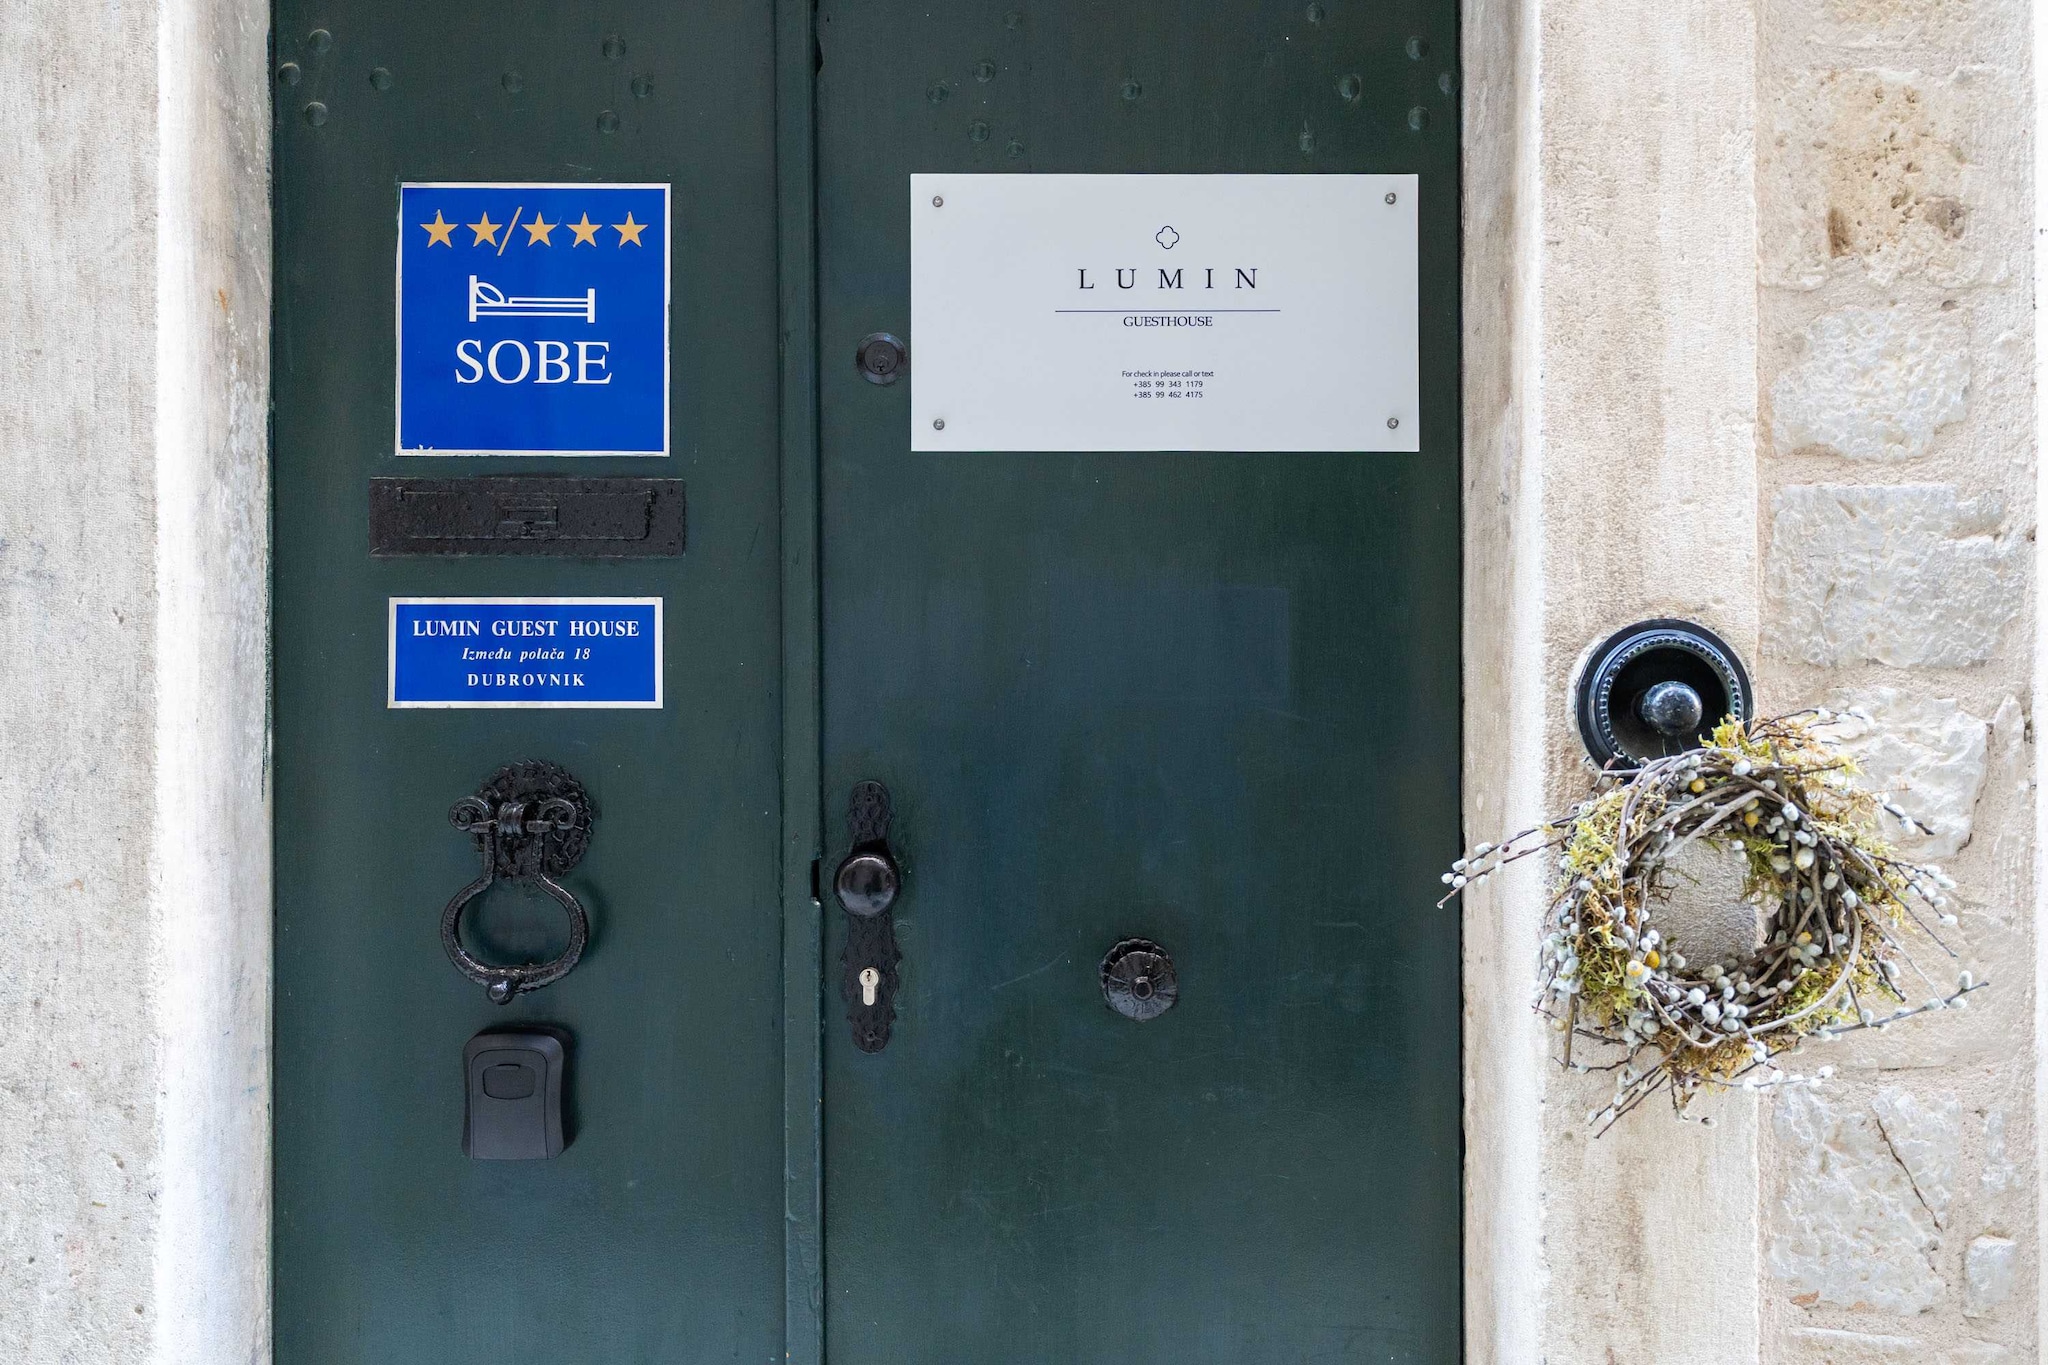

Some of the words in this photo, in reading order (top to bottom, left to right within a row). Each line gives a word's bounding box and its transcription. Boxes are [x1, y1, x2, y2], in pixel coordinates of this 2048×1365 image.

[1077, 268, 1258, 290] LUMIN
[1123, 316, 1213, 327] GUESTHOUSE
[455, 339, 612, 385] SOBE
[1160, 370, 1181, 379] please
[412, 620, 481, 637] LUMIN
[491, 620, 559, 637] GUEST
[569, 620, 640, 637] HOUSE
[461, 647, 512, 661] Između
[519, 647, 565, 663] polača
[574, 647, 591, 661] 18
[467, 673, 585, 687] DUBROVNIK
